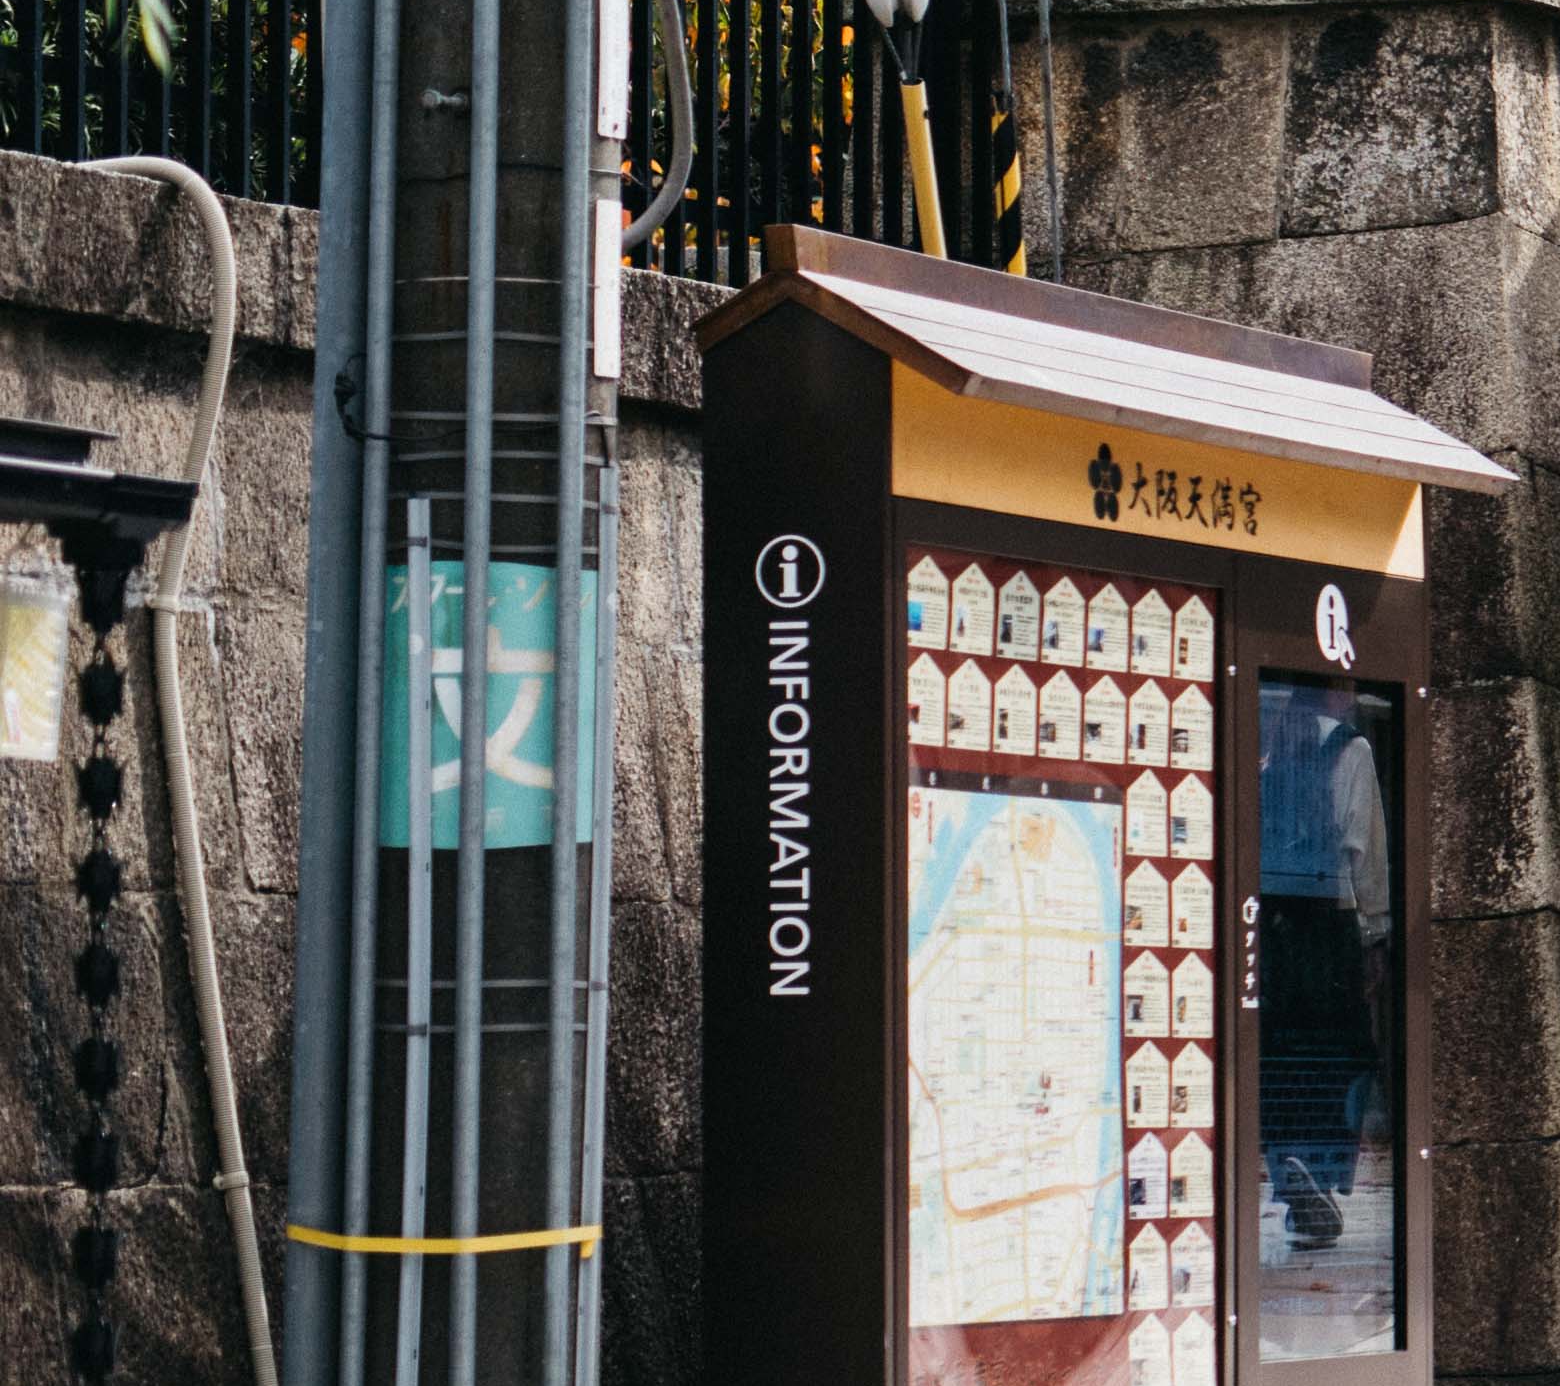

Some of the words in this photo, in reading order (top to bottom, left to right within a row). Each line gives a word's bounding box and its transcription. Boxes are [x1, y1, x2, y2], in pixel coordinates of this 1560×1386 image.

[1127, 460, 1263, 537] 大阪天満宮
[768, 620, 811, 996] INFORMATION
